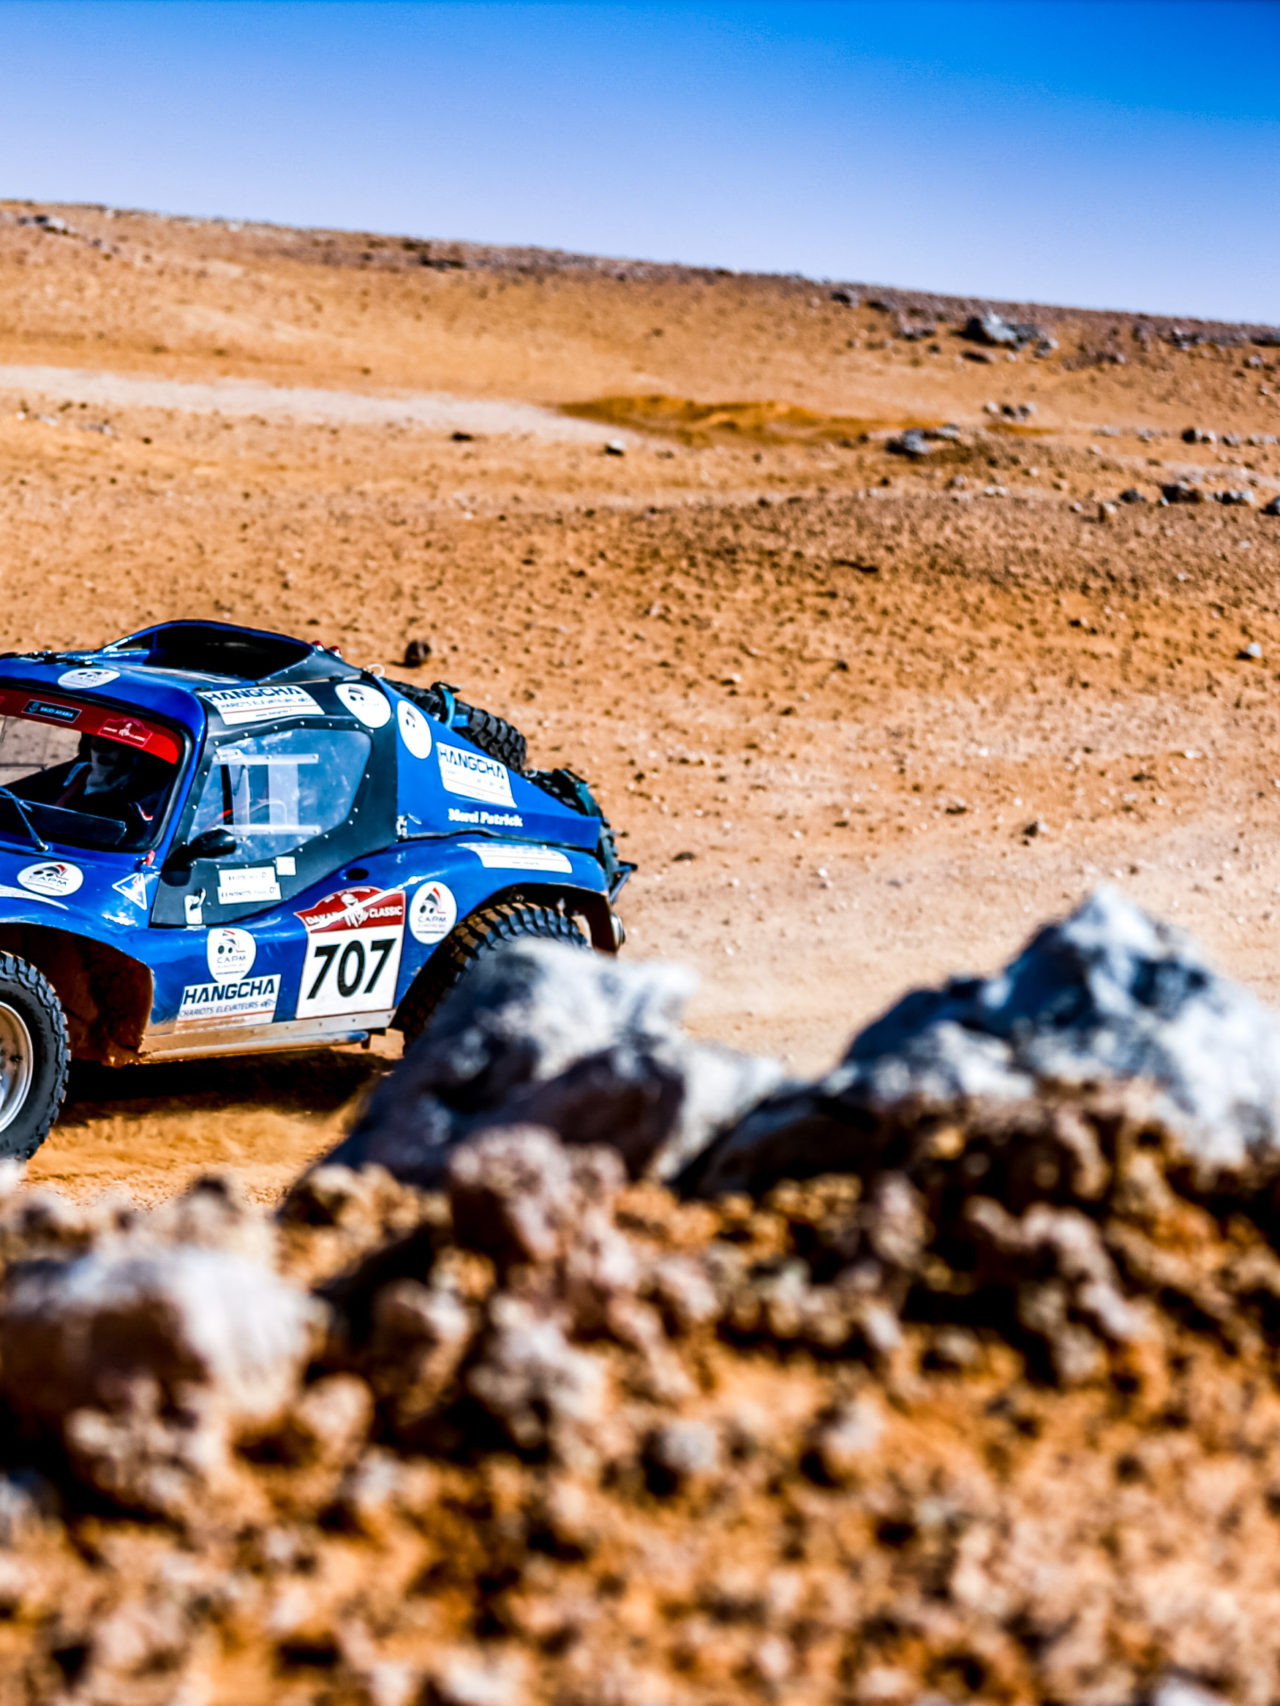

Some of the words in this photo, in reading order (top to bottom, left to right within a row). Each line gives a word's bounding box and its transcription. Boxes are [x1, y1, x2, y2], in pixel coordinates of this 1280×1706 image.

[203, 687, 302, 701] HANGCHA
[440, 748, 505, 780] HANGCHA
[480, 811, 523, 827] Patrick
[369, 905, 403, 918] CLASSIC
[306, 938, 397, 1000] 707
[183, 978, 275, 1005] HANGCHA
